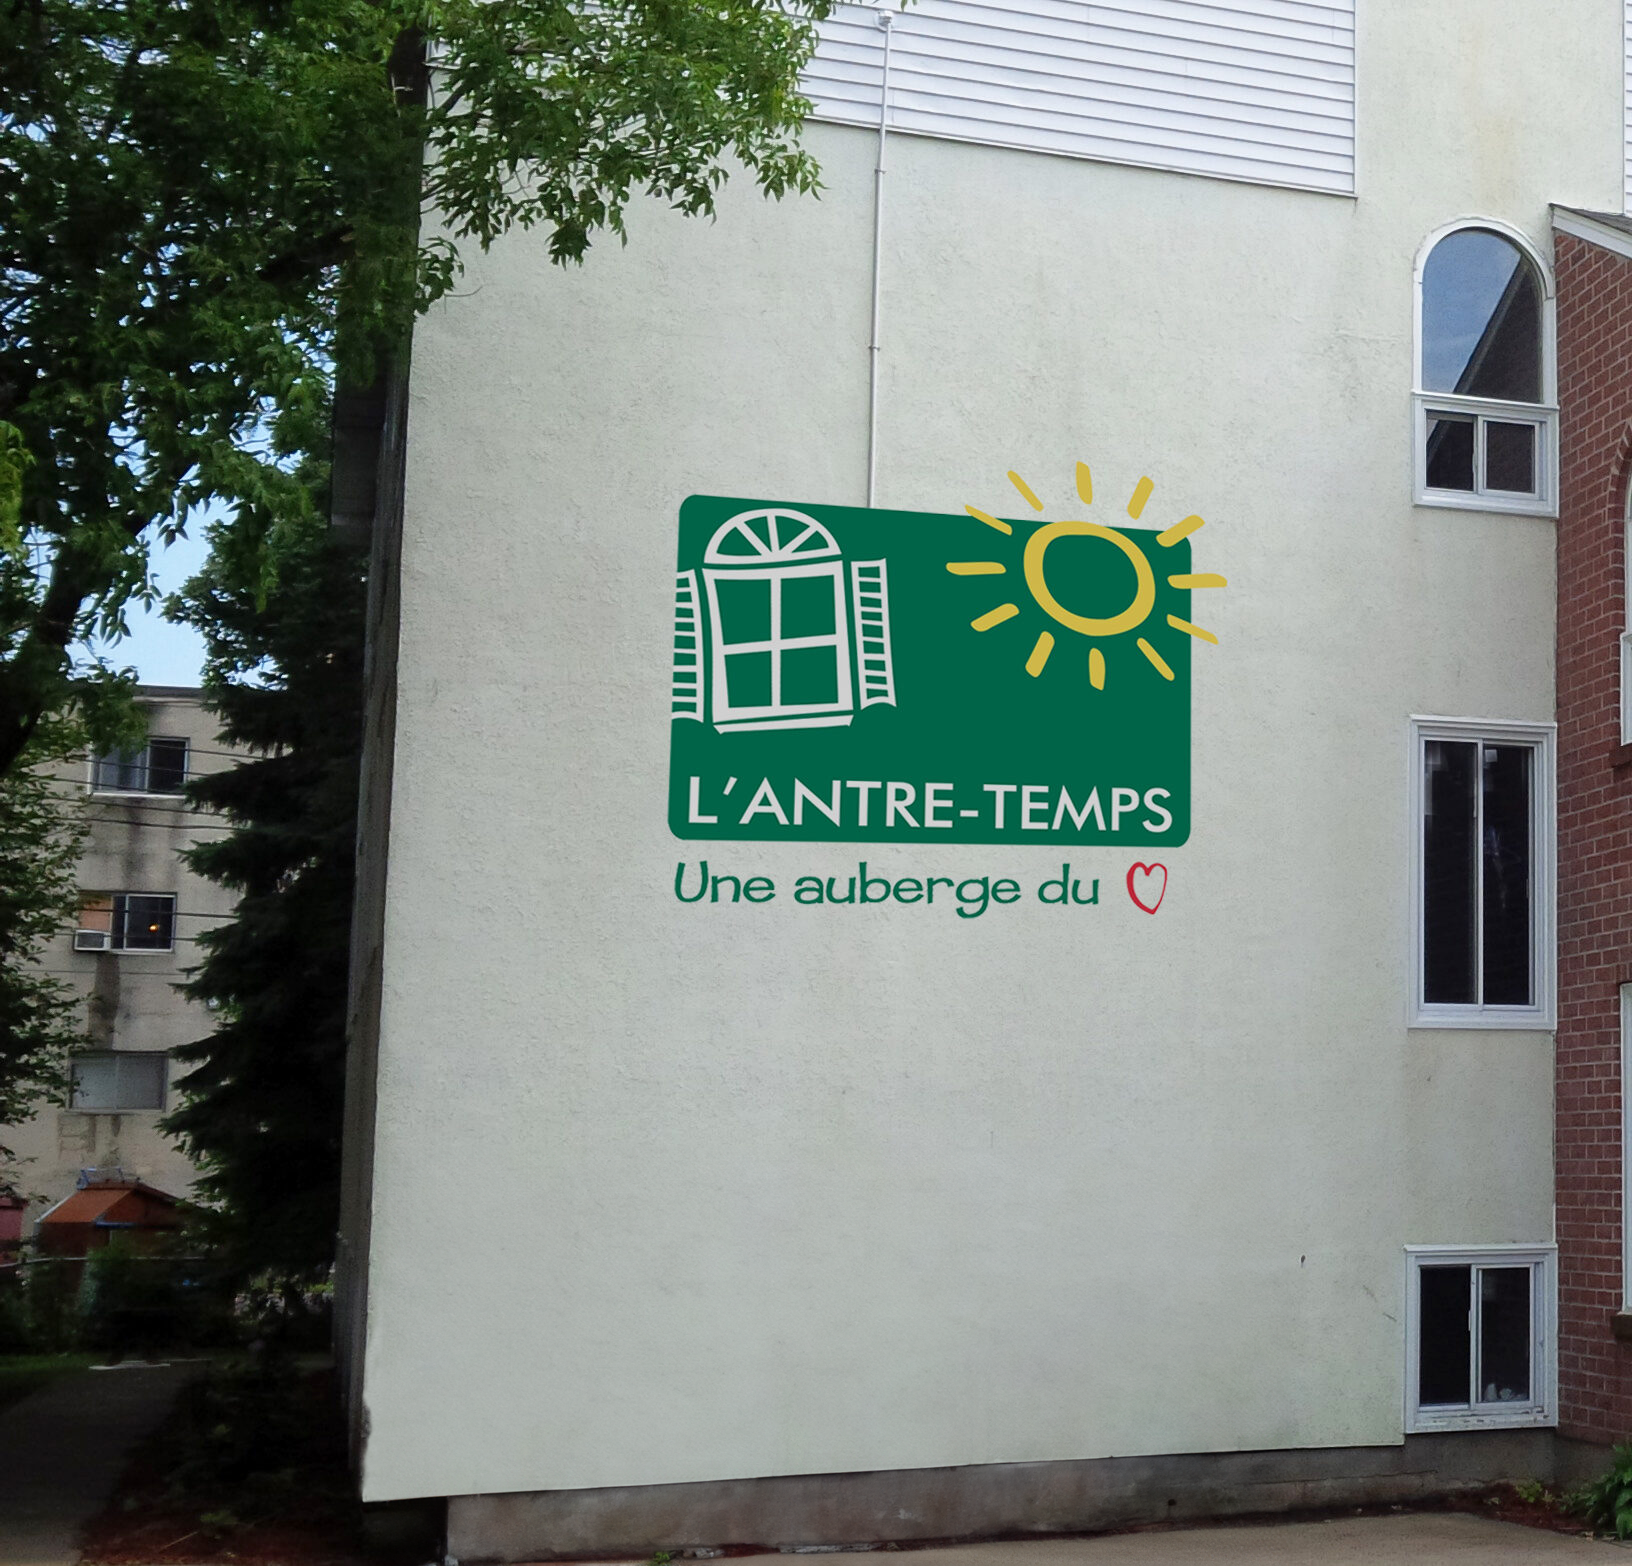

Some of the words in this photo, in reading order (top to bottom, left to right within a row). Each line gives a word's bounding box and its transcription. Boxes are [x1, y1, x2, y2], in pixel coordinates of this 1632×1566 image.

[688, 776, 1173, 833] L'ANTRE-TEMPS
[674, 861, 776, 904] Une
[794, 862, 1021, 919] auberge
[1037, 863, 1100, 905] du
